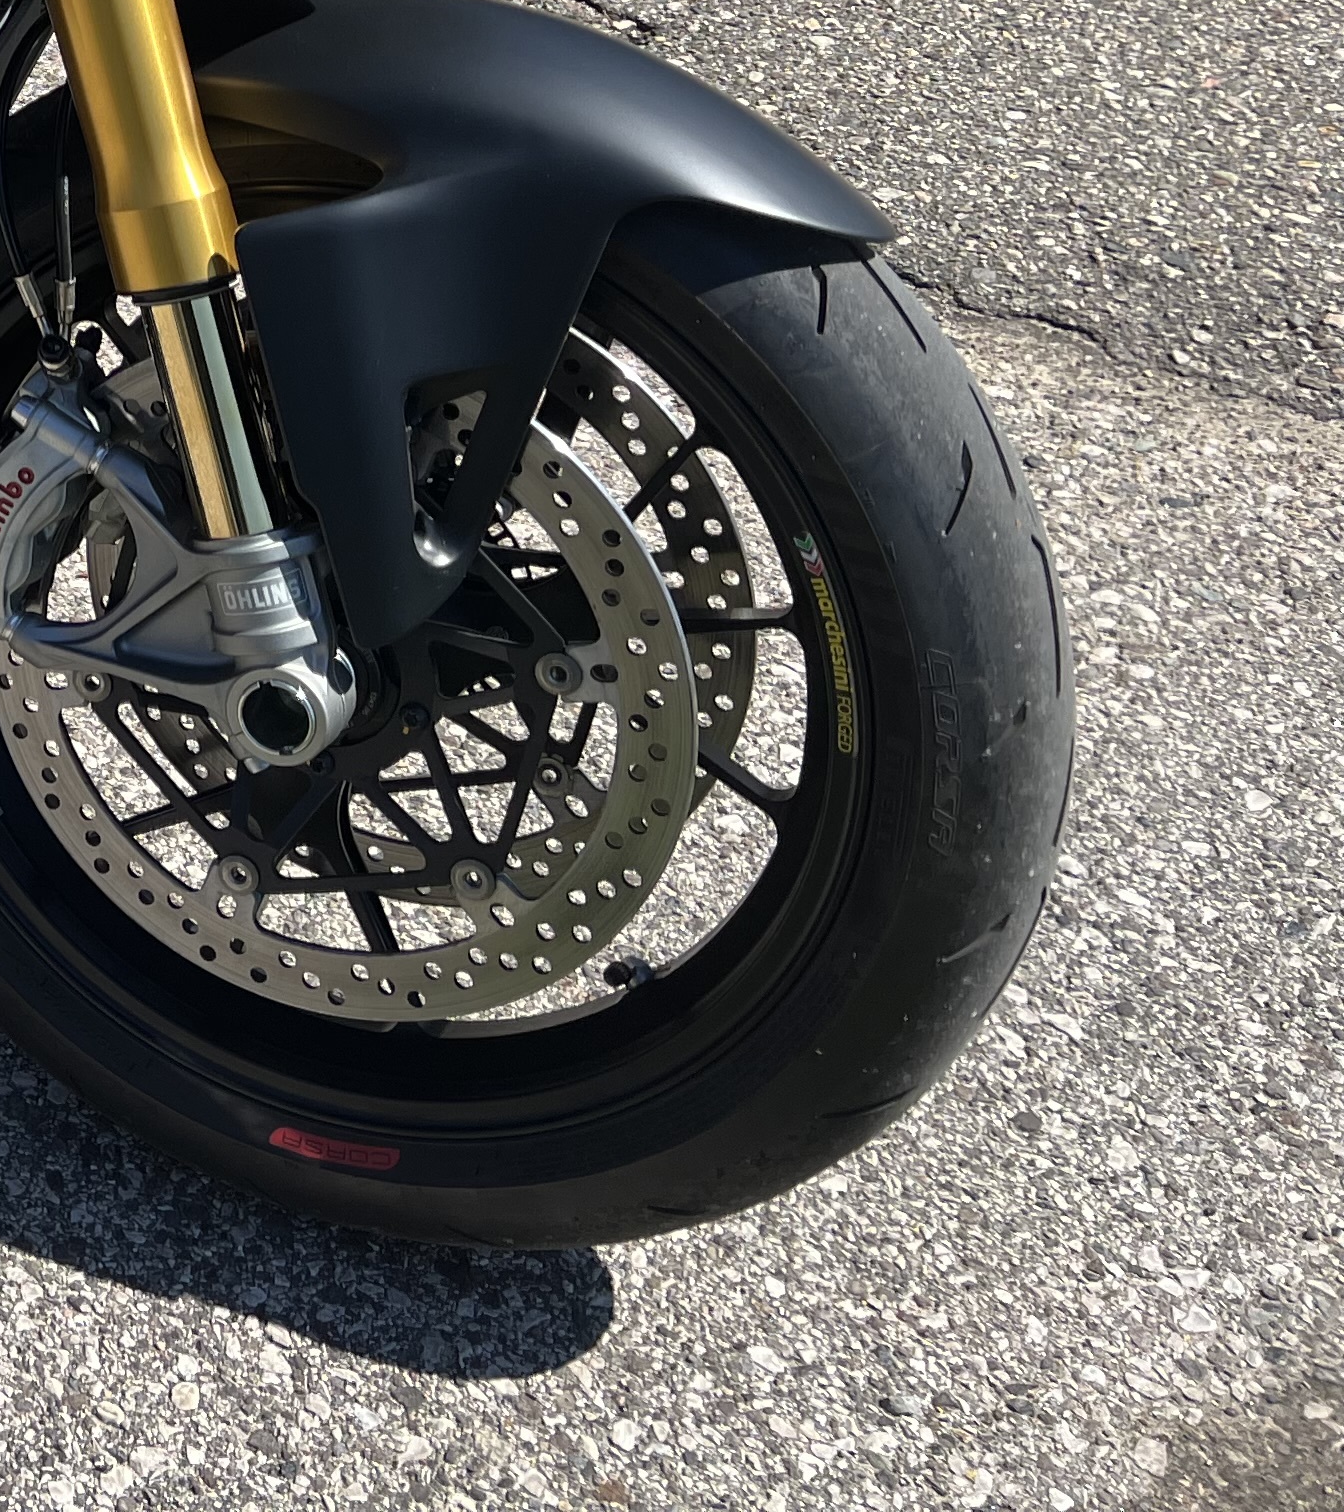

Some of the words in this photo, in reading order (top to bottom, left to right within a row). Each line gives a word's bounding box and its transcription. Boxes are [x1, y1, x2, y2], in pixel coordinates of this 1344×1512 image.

[223, 579, 302, 611] ÖHLINS
[810, 577, 853, 692] marchesini
[836, 694, 854, 754] FORGED
[927, 648, 963, 857] CORSA
[282, 1129, 391, 1166] CORSA
